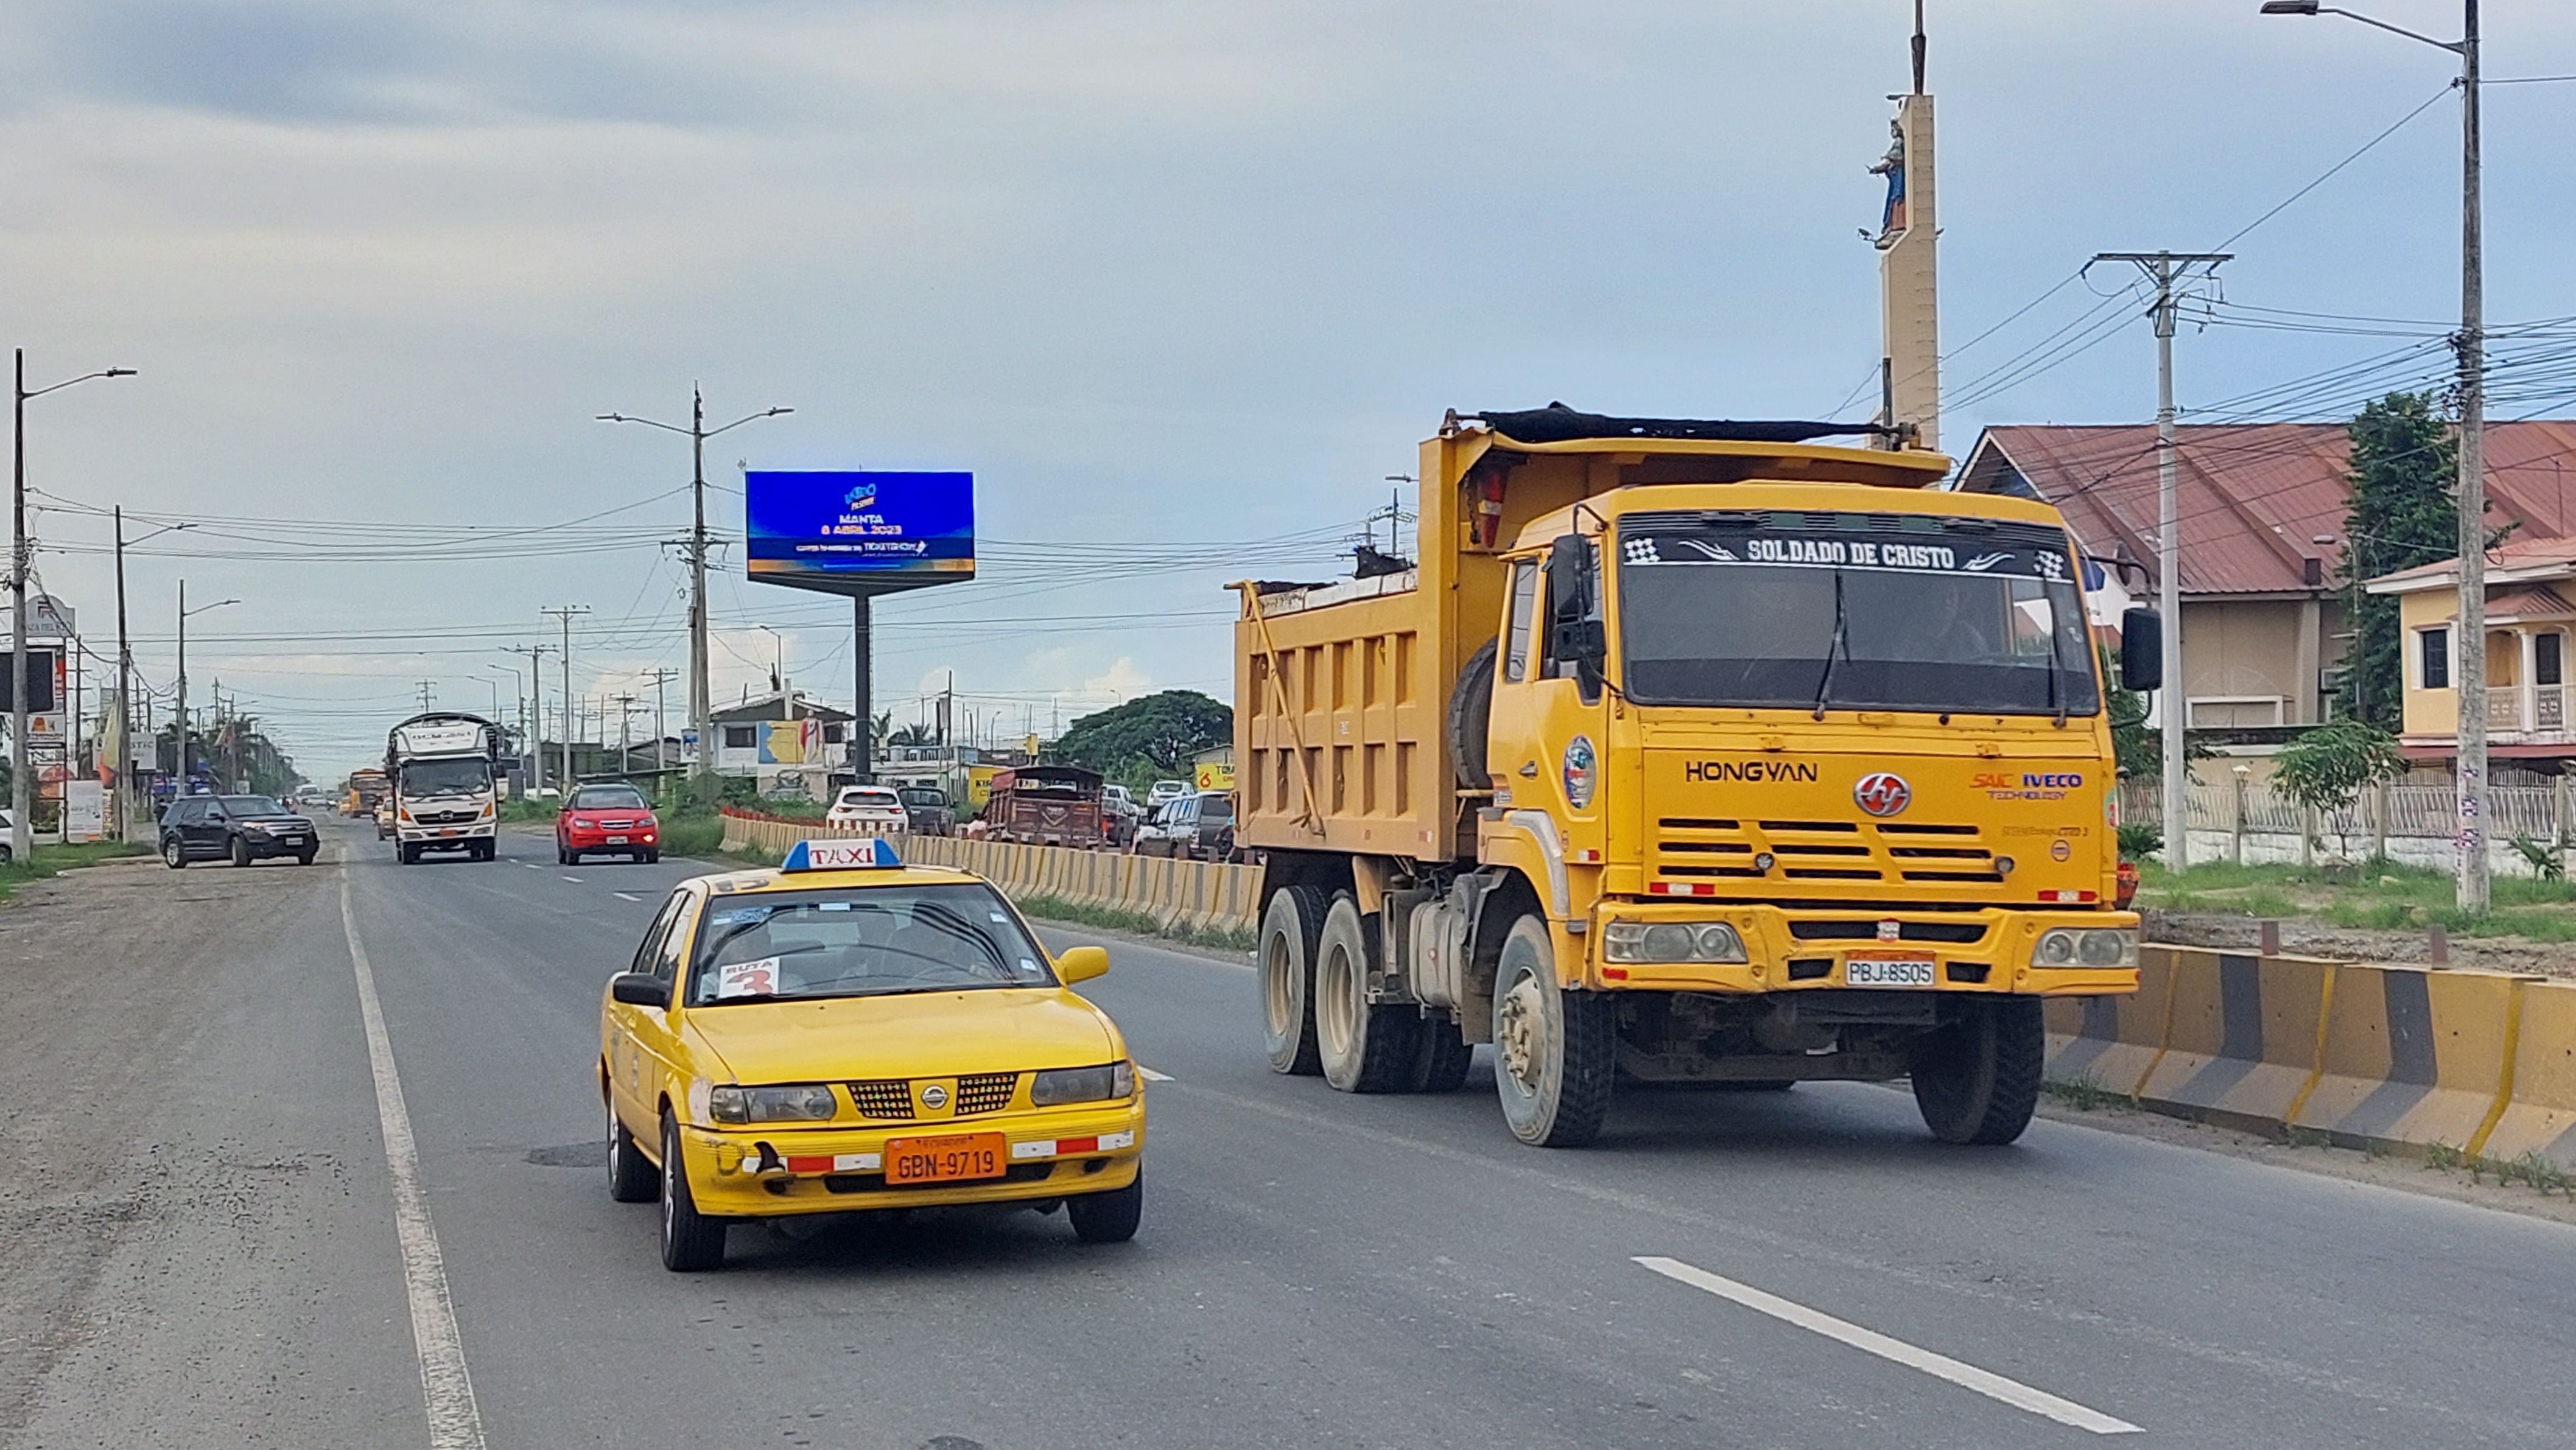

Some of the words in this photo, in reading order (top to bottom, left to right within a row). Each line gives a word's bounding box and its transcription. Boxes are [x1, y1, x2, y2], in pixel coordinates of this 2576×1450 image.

[839, 514, 884, 524] MANTA
[1747, 539, 1846, 564] SOLDADO
[1850, 542, 1879, 565] DE
[1882, 544, 1955, 569] CRISTO
[1686, 762, 1817, 782] HONGYAN
[1969, 774, 2015, 788] SAIC
[2023, 774, 2083, 788] IVECO
[1986, 791, 2068, 800] TECHNOLOGY
[810, 847, 873, 864] TAXI
[726, 961, 773, 974] RUTA
[1849, 963, 1931, 982] PBJ-8505
[898, 1150, 994, 1179] GBN-9719
